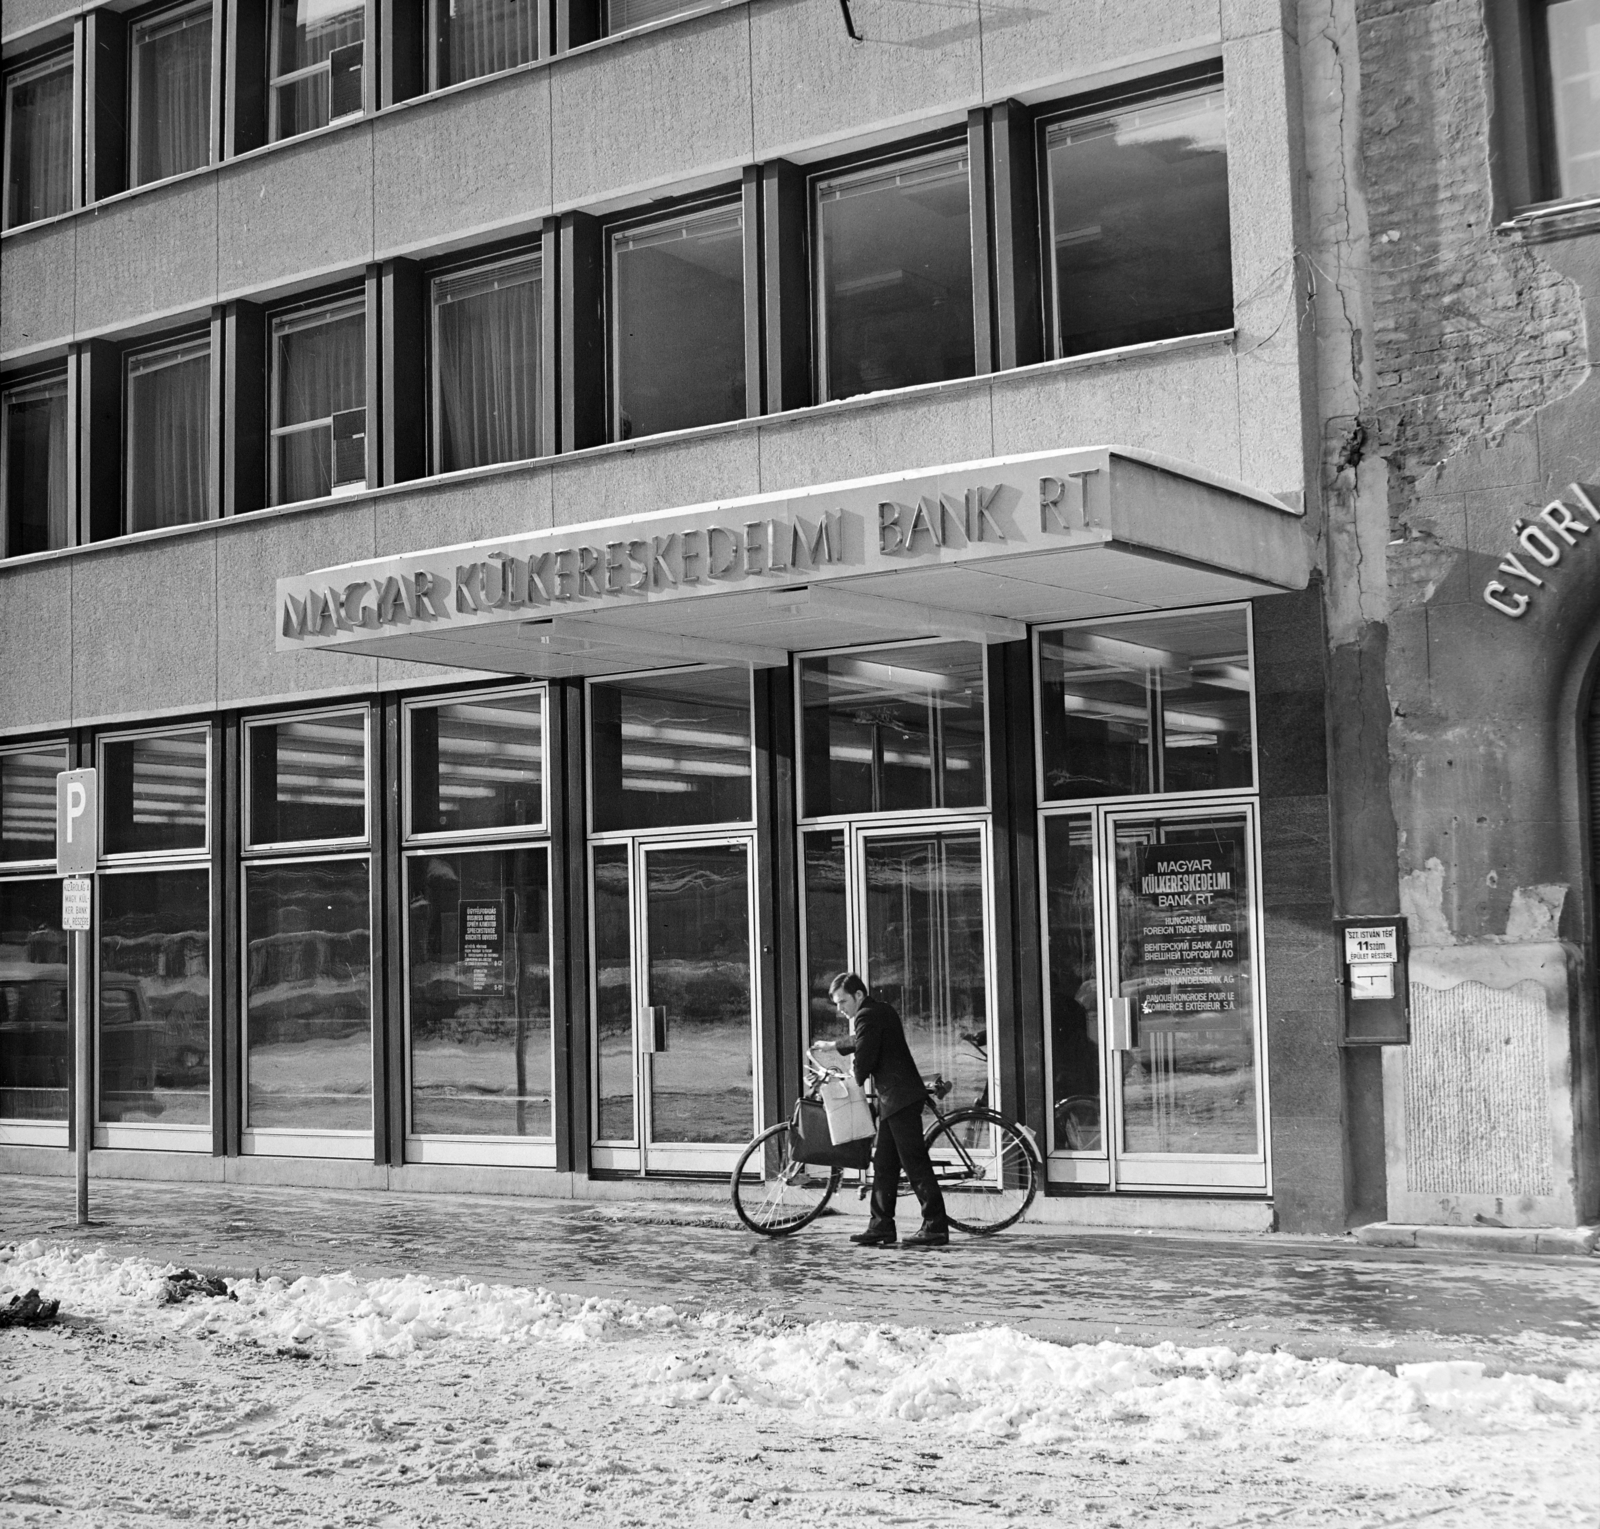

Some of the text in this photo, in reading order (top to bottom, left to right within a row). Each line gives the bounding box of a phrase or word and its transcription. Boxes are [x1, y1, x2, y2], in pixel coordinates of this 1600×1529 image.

[281, 468, 1101, 638] MAGYAR KÜLKERESKEDELMI BANK RT.
[67, 782, 86, 843] P
[1157, 859, 1212, 873] MAGYAR
[1142, 872, 1231, 894] KÜLKERESKEDELMI
[1158, 894, 1193, 907] BANK
[1165, 916, 1207, 925] HUNGARIAN
[1143, 926, 1174, 935] FOREIGN
[1176, 925, 1197, 933] TRADE
[1199, 924, 1218, 932] BANK
[1360, 929, 1380, 938] ISTVÁN
[1144, 940, 1233, 952] ВЕНГЕРСКИЙ БАНК ДЛЯ
[1357, 941, 1369, 951] 11
[1144, 951, 1181, 961] ВНЕШНЕЙ
[1182, 950, 1220, 959] ТОРГОВЛИ
[1350, 951, 1393, 960] ÉPÜLET RÉSZÉRE
[1164, 967, 1213, 976] UNGARISCHE
[1145, 975, 1235, 986] AUSSENHANDELSBANK AG
[1146, 992, 1235, 1002] BANQUE HONGROISE POUR LE
[1185, 1001, 1220, 1011] EXTÉRIEUR
